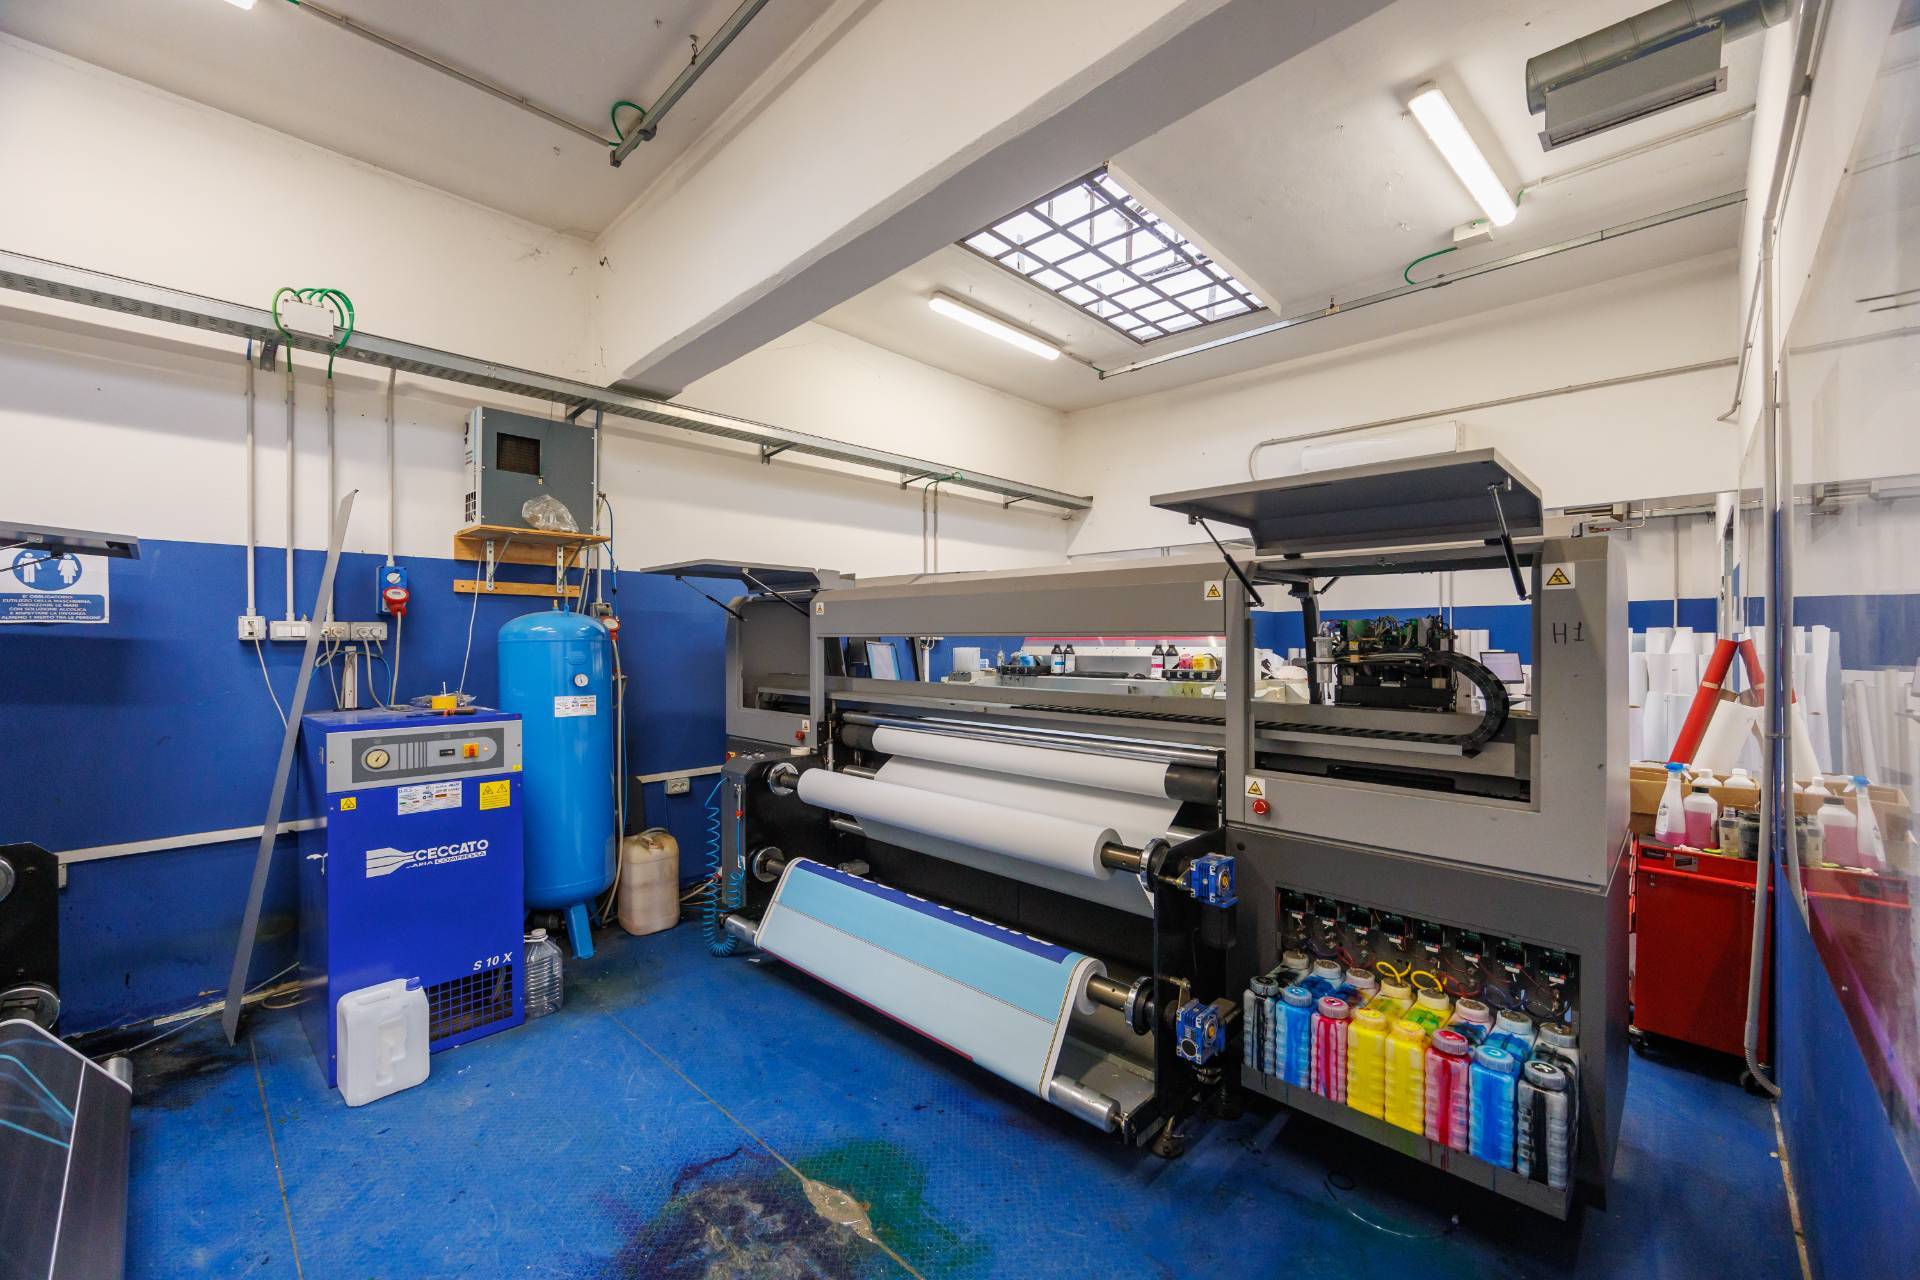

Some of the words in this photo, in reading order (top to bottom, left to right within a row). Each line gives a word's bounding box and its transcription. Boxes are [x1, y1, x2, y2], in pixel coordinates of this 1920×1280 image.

[415, 839, 489, 861] CECCATO
[473, 960, 483, 971] S
[486, 955, 500, 967] 10
[502, 951, 513, 964] X
